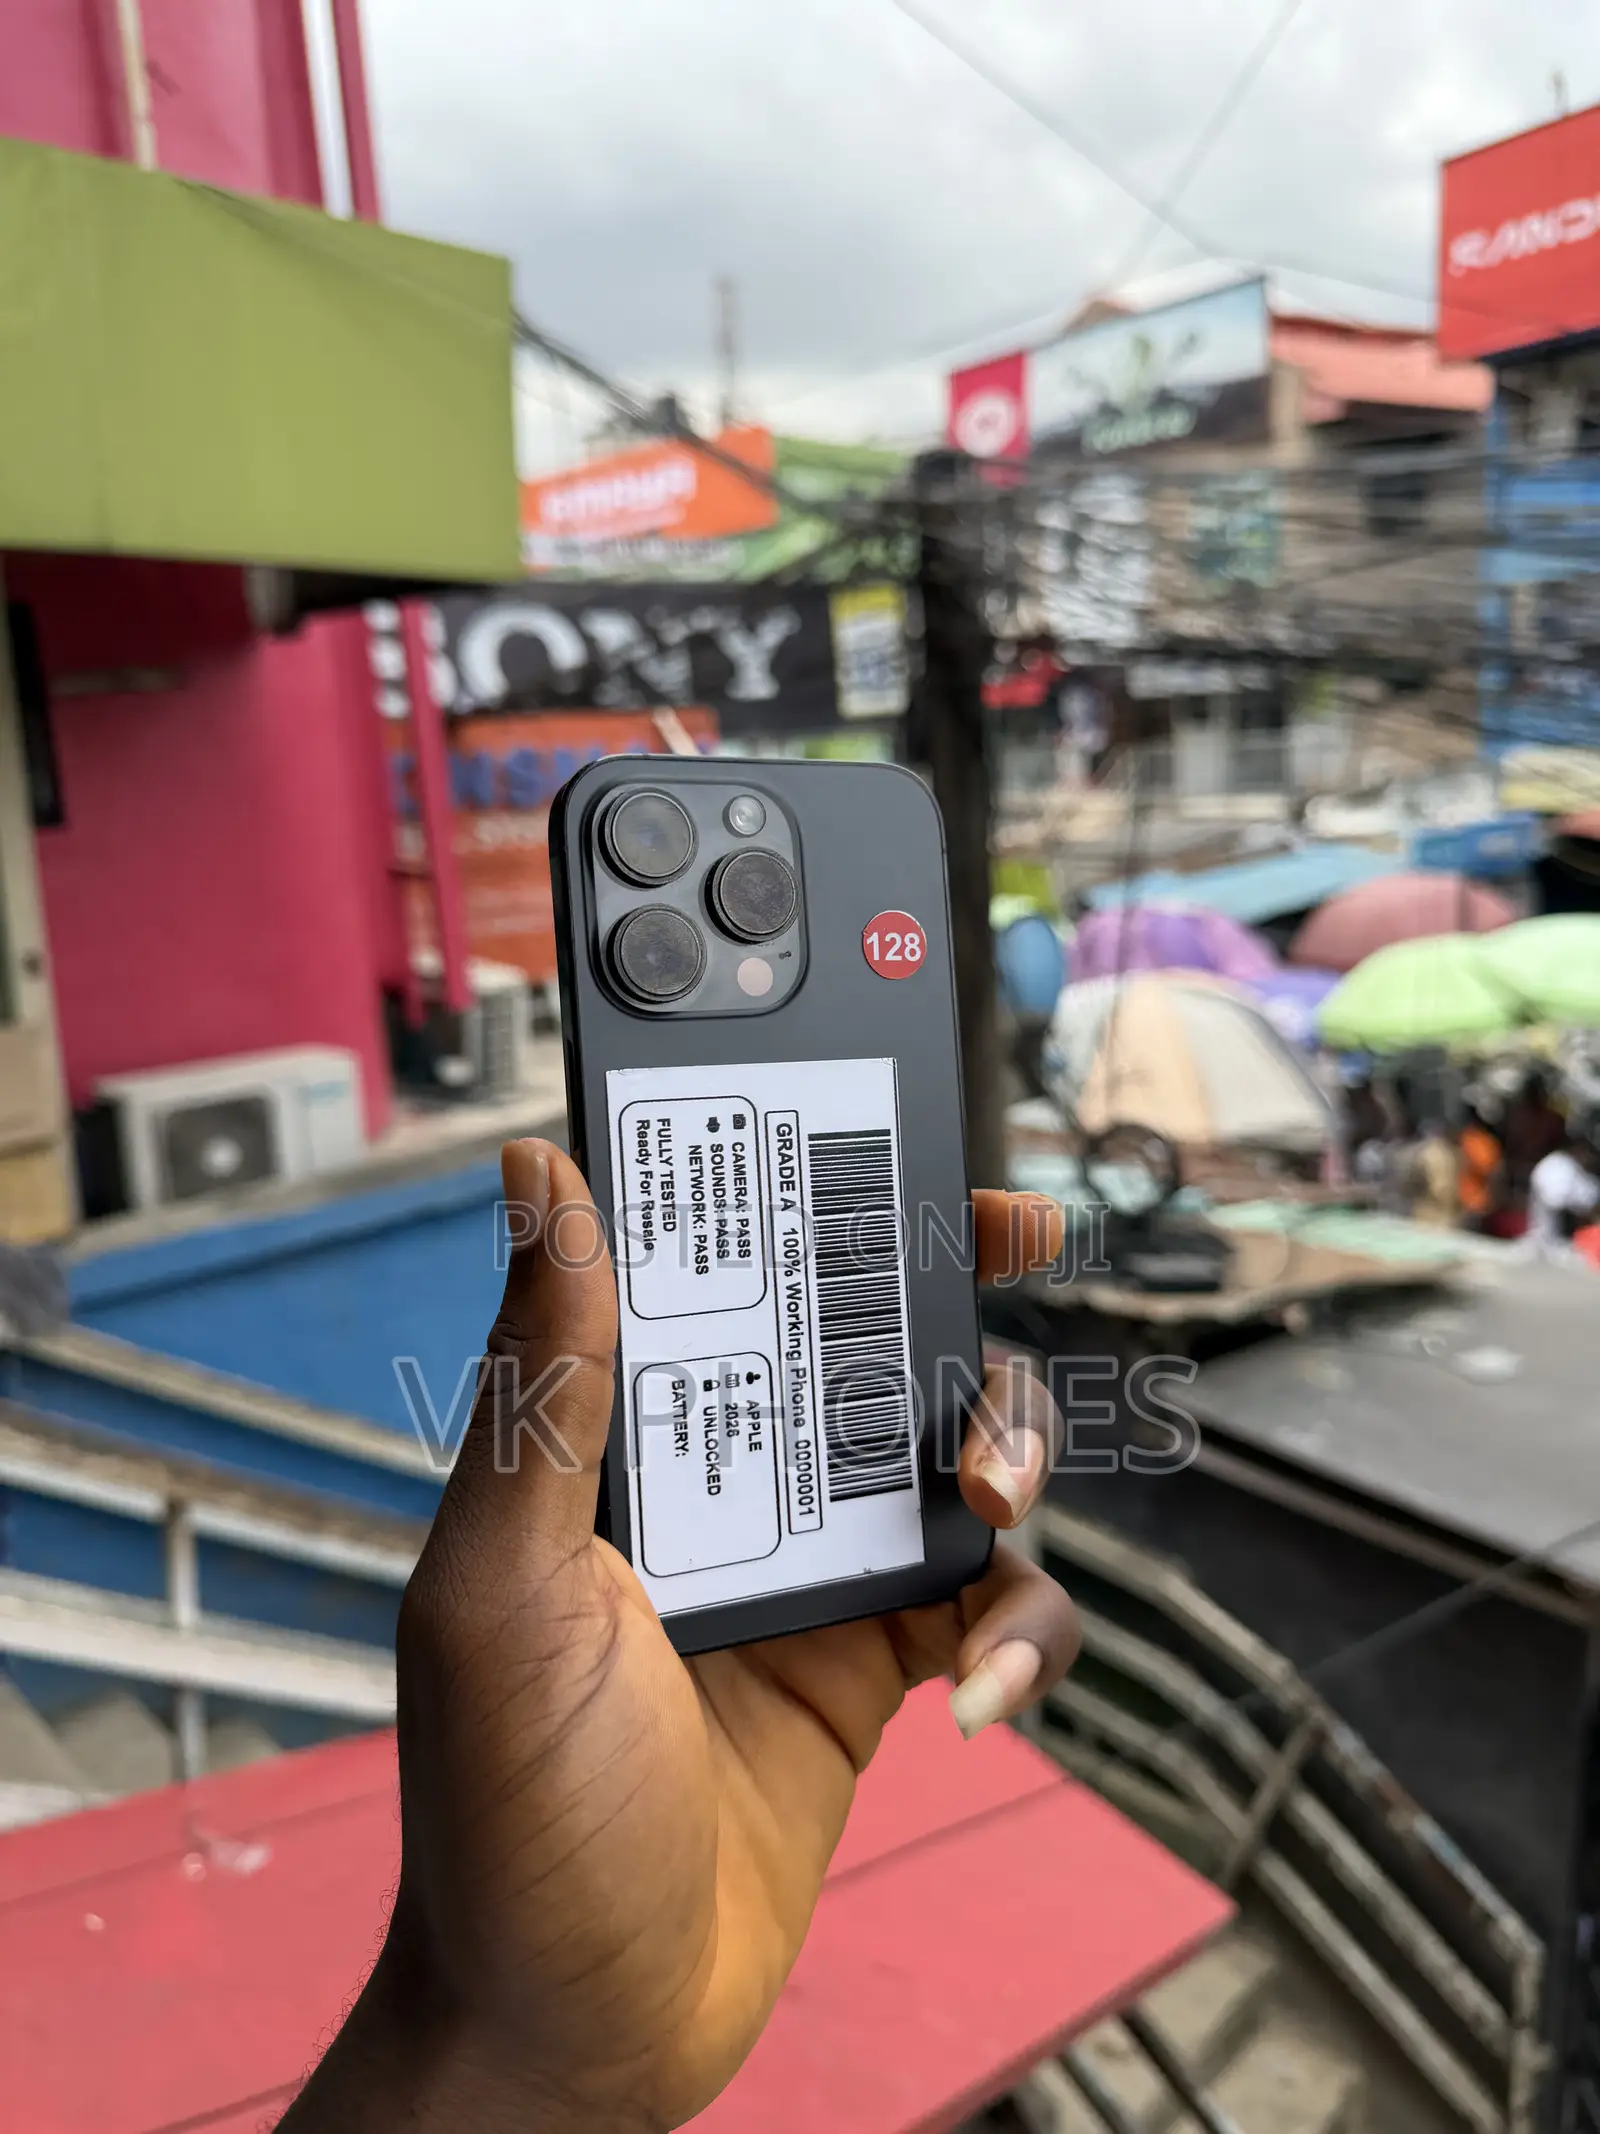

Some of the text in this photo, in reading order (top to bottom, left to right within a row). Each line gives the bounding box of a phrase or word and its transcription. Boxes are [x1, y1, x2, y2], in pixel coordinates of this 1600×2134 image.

[866, 932, 922, 962] 128
[635, 1119, 656, 1252] Ready For Resale
[657, 1117, 676, 1233] FULLY TESTED
[688, 1144, 709, 1276] NETWORK: PASS
[710, 1143, 730, 1260] SOUNDS: PASS
[731, 1141, 751, 1259] CAMERA: PASS
[775, 1122, 815, 1517] GRADE A 100% Working Phone 0000001
[671, 1379, 689, 1457] BATTERY:
[703, 1405, 720, 1496] UNLOCKED
[745, 1399, 762, 1453] APPLE
